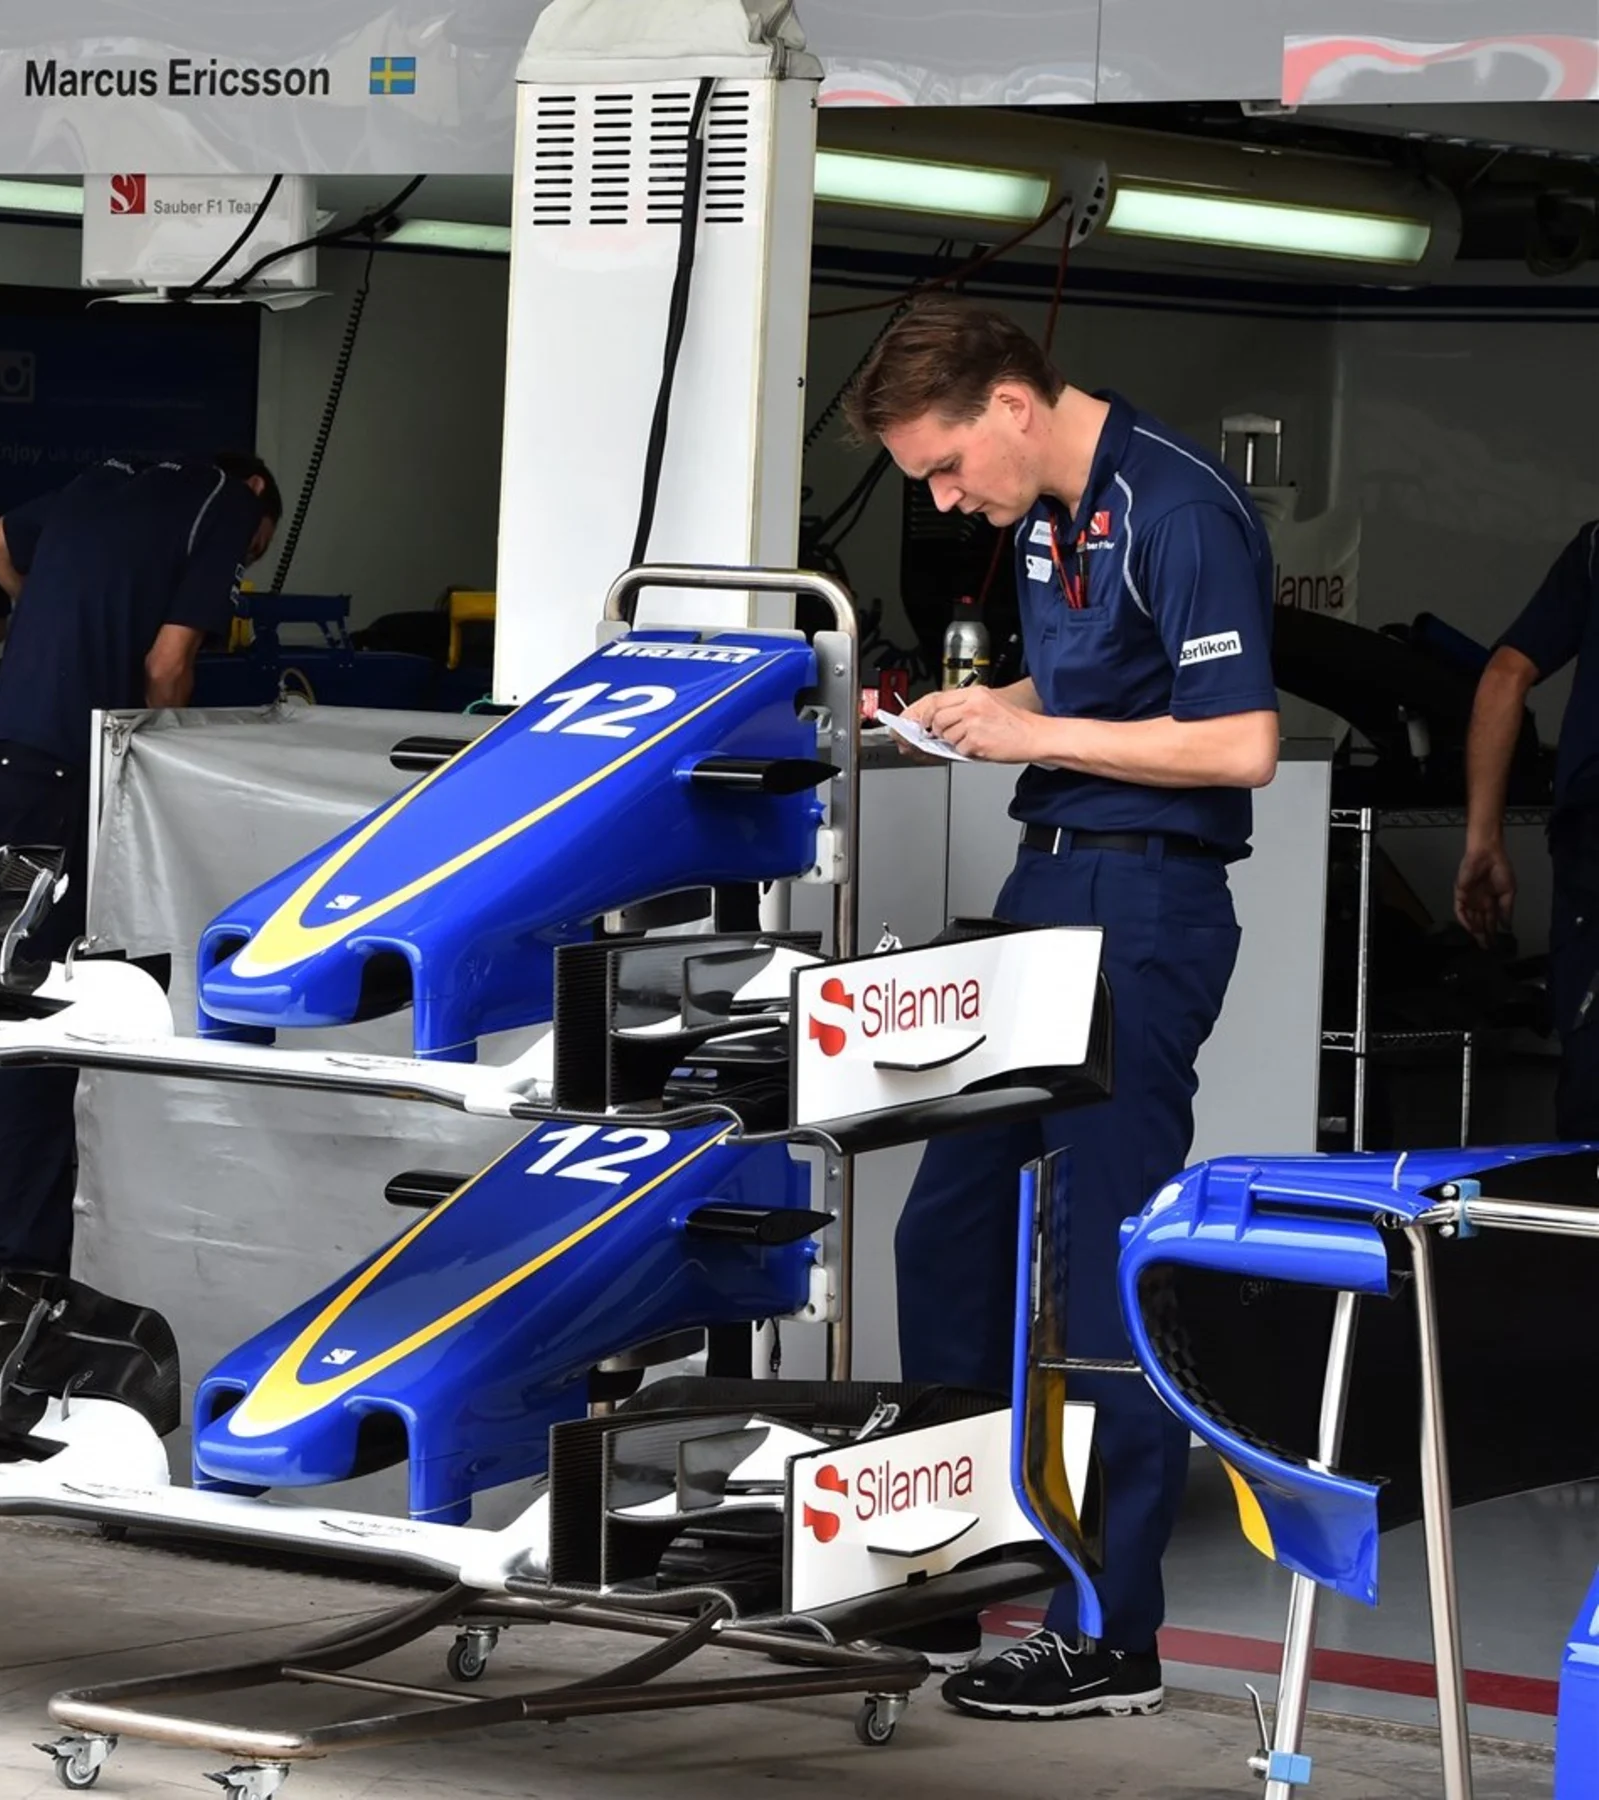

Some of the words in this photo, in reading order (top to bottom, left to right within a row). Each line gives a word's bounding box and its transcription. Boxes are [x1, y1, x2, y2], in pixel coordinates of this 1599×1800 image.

[24, 59, 158, 97] Marcus
[167, 58, 330, 97] Ericsson
[153, 199, 203, 215] Sauber
[206, 199, 222, 214] F1
[1275, 563, 1344, 610] lanna
[601, 641, 761, 664] PIRELLI
[529, 682, 677, 738] 12
[862, 978, 980, 1038] Silanna
[524, 1124, 671, 1185] 12
[856, 1456, 973, 1521] Silanna
